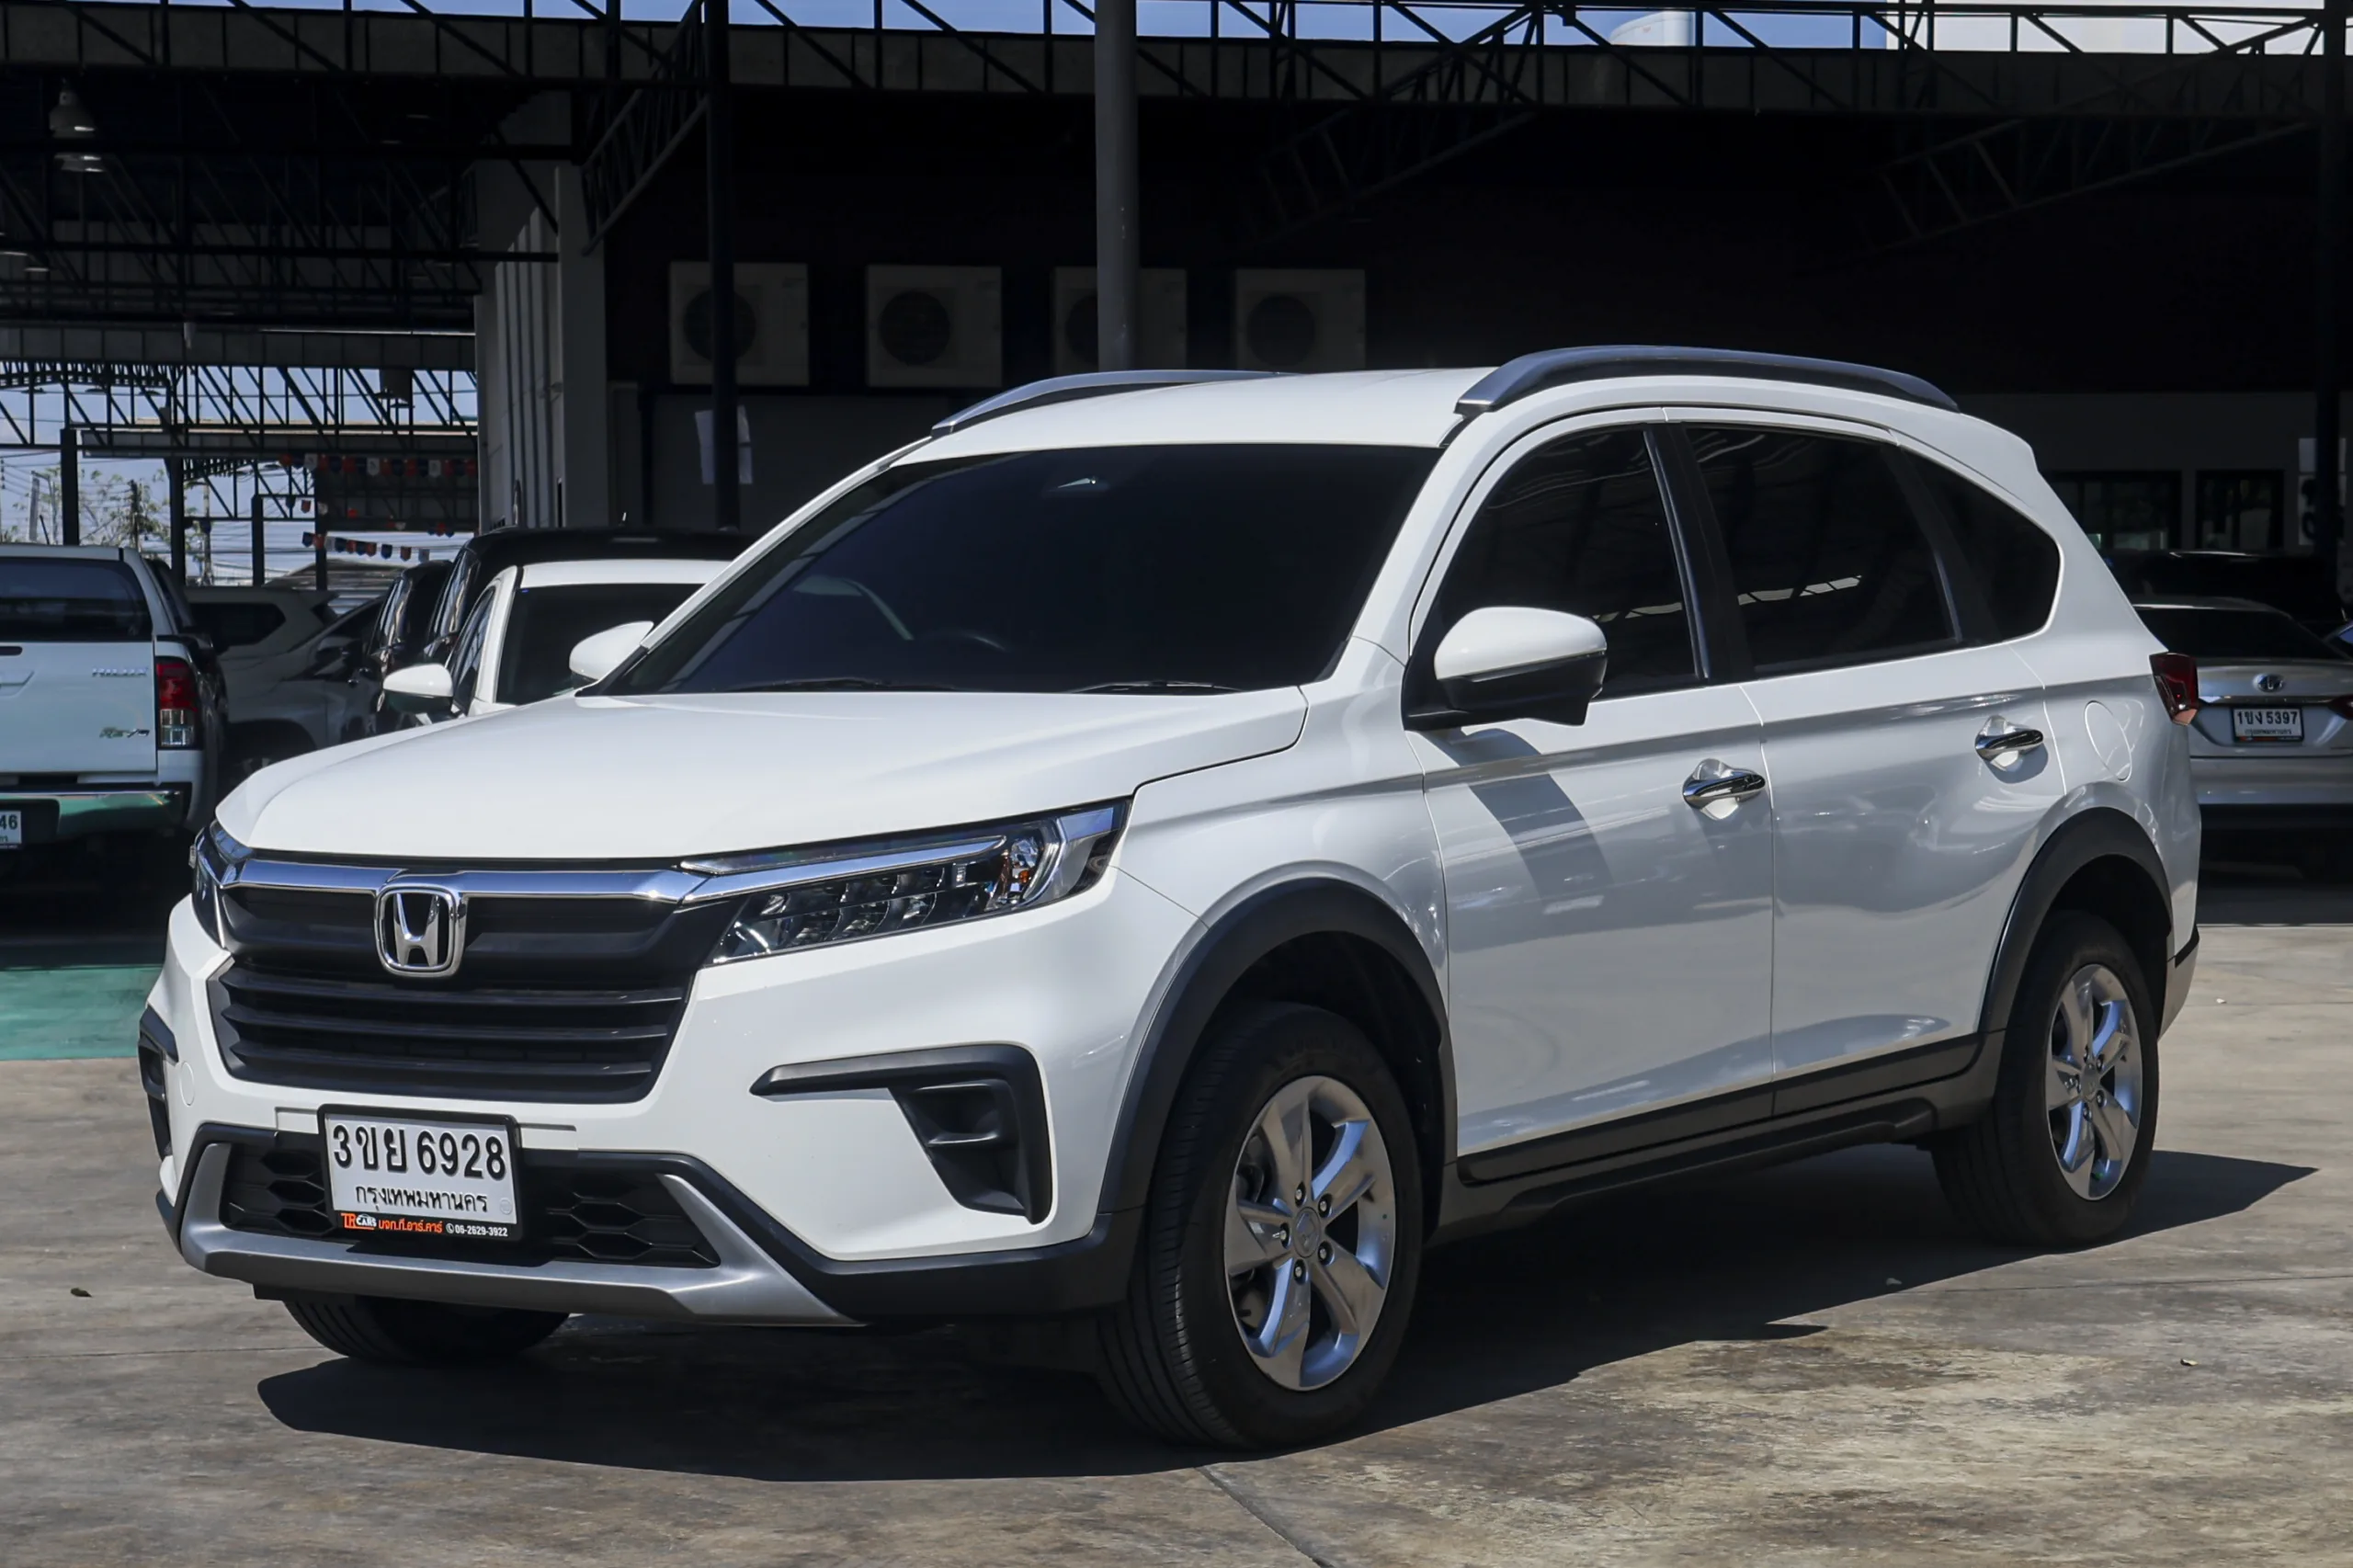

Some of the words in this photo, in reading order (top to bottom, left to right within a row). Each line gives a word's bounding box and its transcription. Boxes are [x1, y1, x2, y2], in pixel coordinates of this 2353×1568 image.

[2266, 710, 2298, 724] 5397
[333, 1124, 408, 1174] 3ขย
[416, 1130, 506, 1180] 6928
[355, 1185, 488, 1212] กรุงเทพมหานคร
